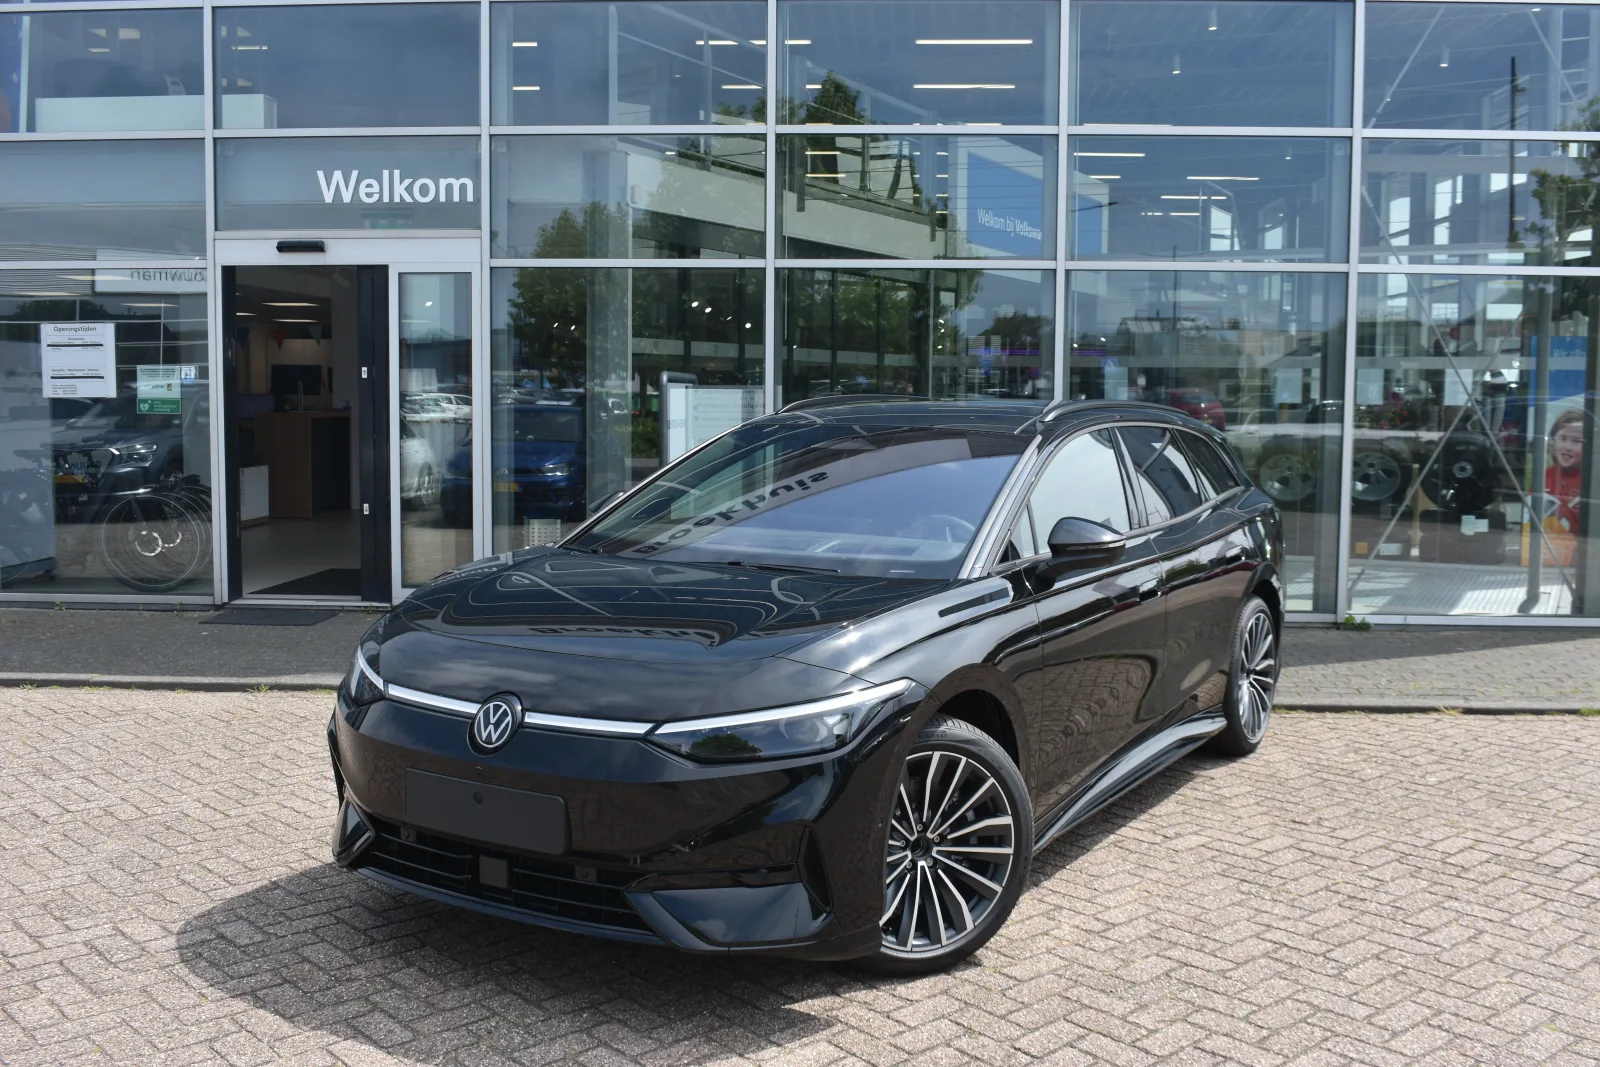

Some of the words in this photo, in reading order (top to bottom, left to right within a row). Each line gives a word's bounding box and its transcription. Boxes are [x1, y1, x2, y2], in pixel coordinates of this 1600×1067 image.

[317, 169, 474, 203] Welkom
[977, 208, 1005, 230] Welkom
[1006, 216, 1014, 236] bij
[1015, 218, 1042, 241] Volkswa
